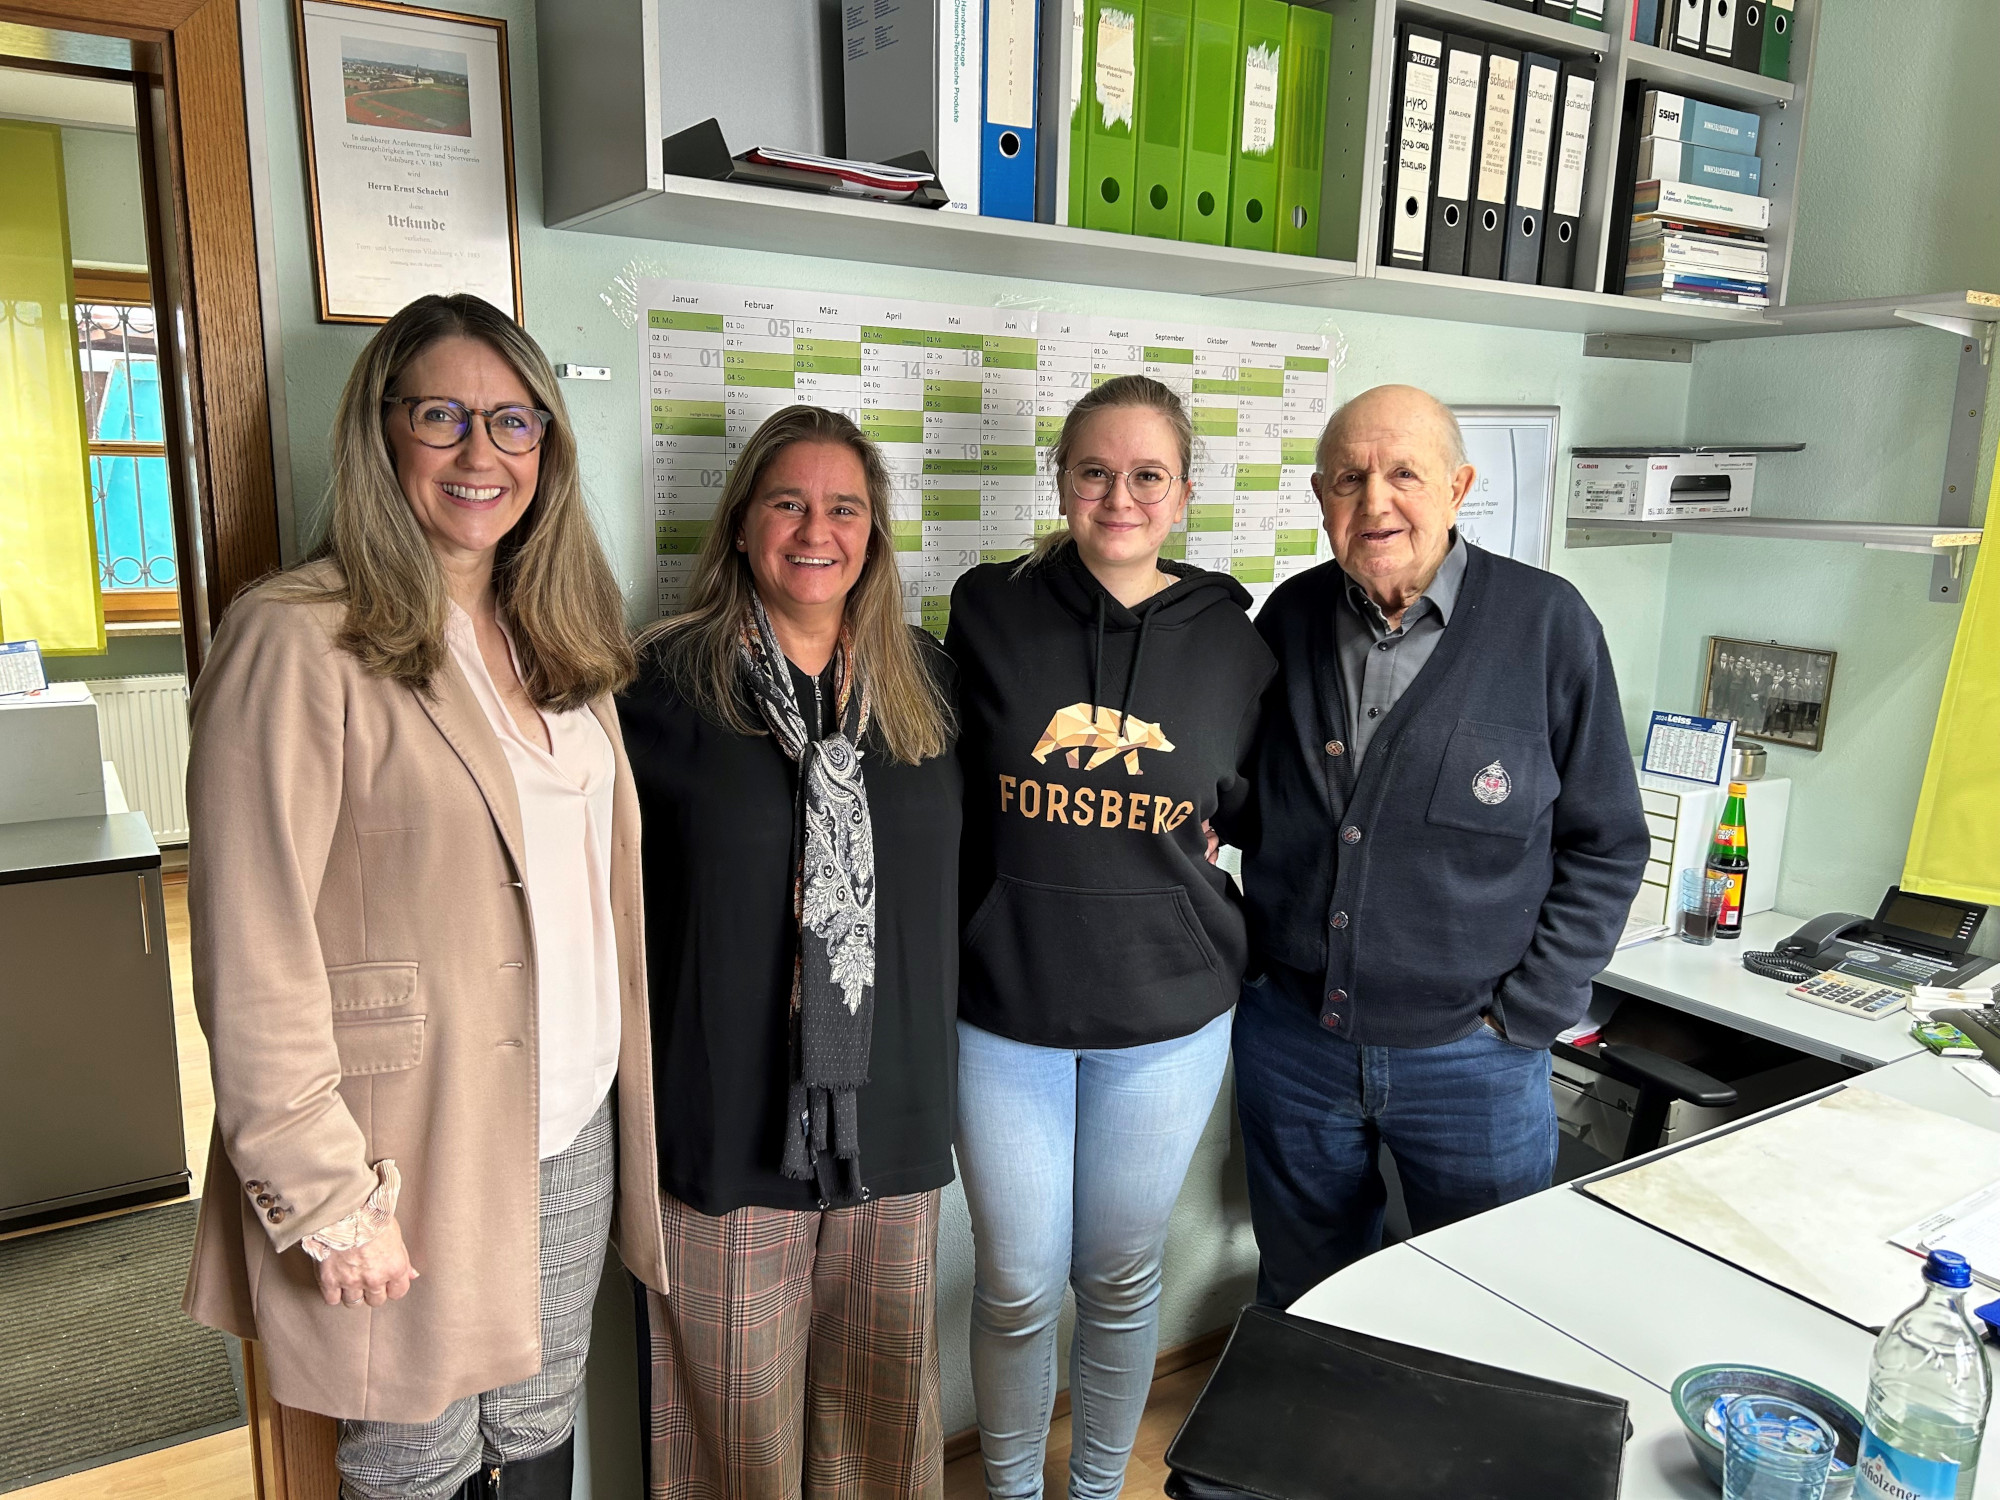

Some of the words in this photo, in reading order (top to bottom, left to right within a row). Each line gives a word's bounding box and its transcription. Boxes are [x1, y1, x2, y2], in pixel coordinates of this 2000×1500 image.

[1416, 53, 1436, 67] LEITZ
[1254, 83, 1271, 92] Jahres
[1249, 100, 1274, 110] abschluss
[1405, 97, 1428, 110] HYPO
[1448, 110, 1471, 119] DARLEHEN
[1658, 108, 1680, 123] Leiss
[1254, 118, 1267, 126] 2012
[1253, 126, 1267, 135] 2013
[360, 135, 391, 145] dankbarer
[392, 138, 432, 150] Anerkennung
[341, 141, 405, 155] Vereinszugehörigkeit
[434, 152, 446, 160] und
[447, 153, 480, 163] Sportverein
[367, 181, 392, 191] Herrn
[393, 184, 416, 194] Ernst
[416, 186, 449, 197] Schachtl
[409, 202, 424, 210] diese
[951, 201, 968, 211] 10/23
[387, 214, 446, 231] Urkunde
[672, 295, 699, 304] Januar
[744, 300, 774, 310] Februar
[819, 306, 838, 315] März
[885, 312, 902, 321] April
[767, 319, 791, 337] 05
[948, 317, 961, 325] Mai
[1060, 326, 1071, 334] Juli
[1109, 330, 1129, 339] August
[1155, 333, 1185, 343] September
[1206, 337, 1229, 345] Oktober
[1251, 341, 1277, 349] November
[1127, 345, 1141, 361] 31
[1296, 344, 1321, 352] Dezember
[700, 350, 721, 368] 01
[962, 350, 980, 367] 18
[901, 361, 921, 379] 14
[1221, 366, 1237, 380] 40
[1070, 372, 1089, 388] 27
[1016, 400, 1034, 415] 23
[1309, 398, 1324, 412] 49
[1264, 423, 1280, 438] 45
[961, 444, 979, 460] 19
[1221, 464, 1236, 478] 41
[700, 469, 723, 488] 02
[1014, 505, 1032, 521] 24
[1259, 516, 1274, 531] 46
[958, 550, 977, 566] 20
[1213, 557, 1229, 572] 42
[1667, 714, 1692, 725] Leiss
[999, 773, 1194, 835] FORSBERG
